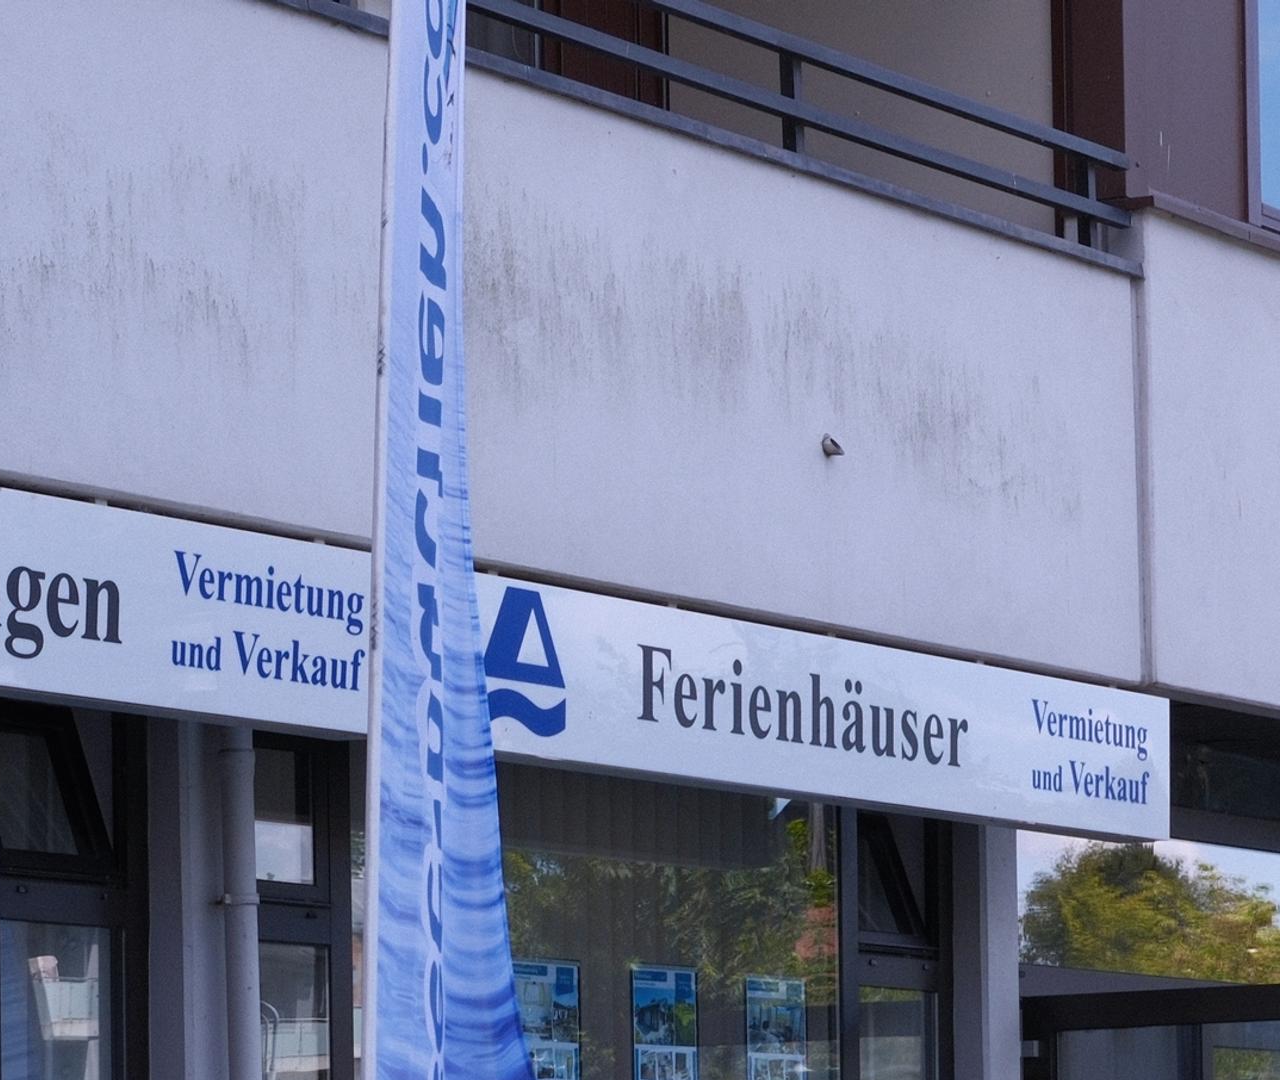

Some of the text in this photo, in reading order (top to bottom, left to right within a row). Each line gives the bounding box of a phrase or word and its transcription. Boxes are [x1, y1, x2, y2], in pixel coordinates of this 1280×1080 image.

[174, 549, 365, 636] Vermietung
[171, 630, 366, 691] und Verkauf
[637, 644, 970, 768] Ferienhäuser
[1031, 698, 1148, 761] Vermietung
[1031, 759, 1150, 805] und Verkauf
